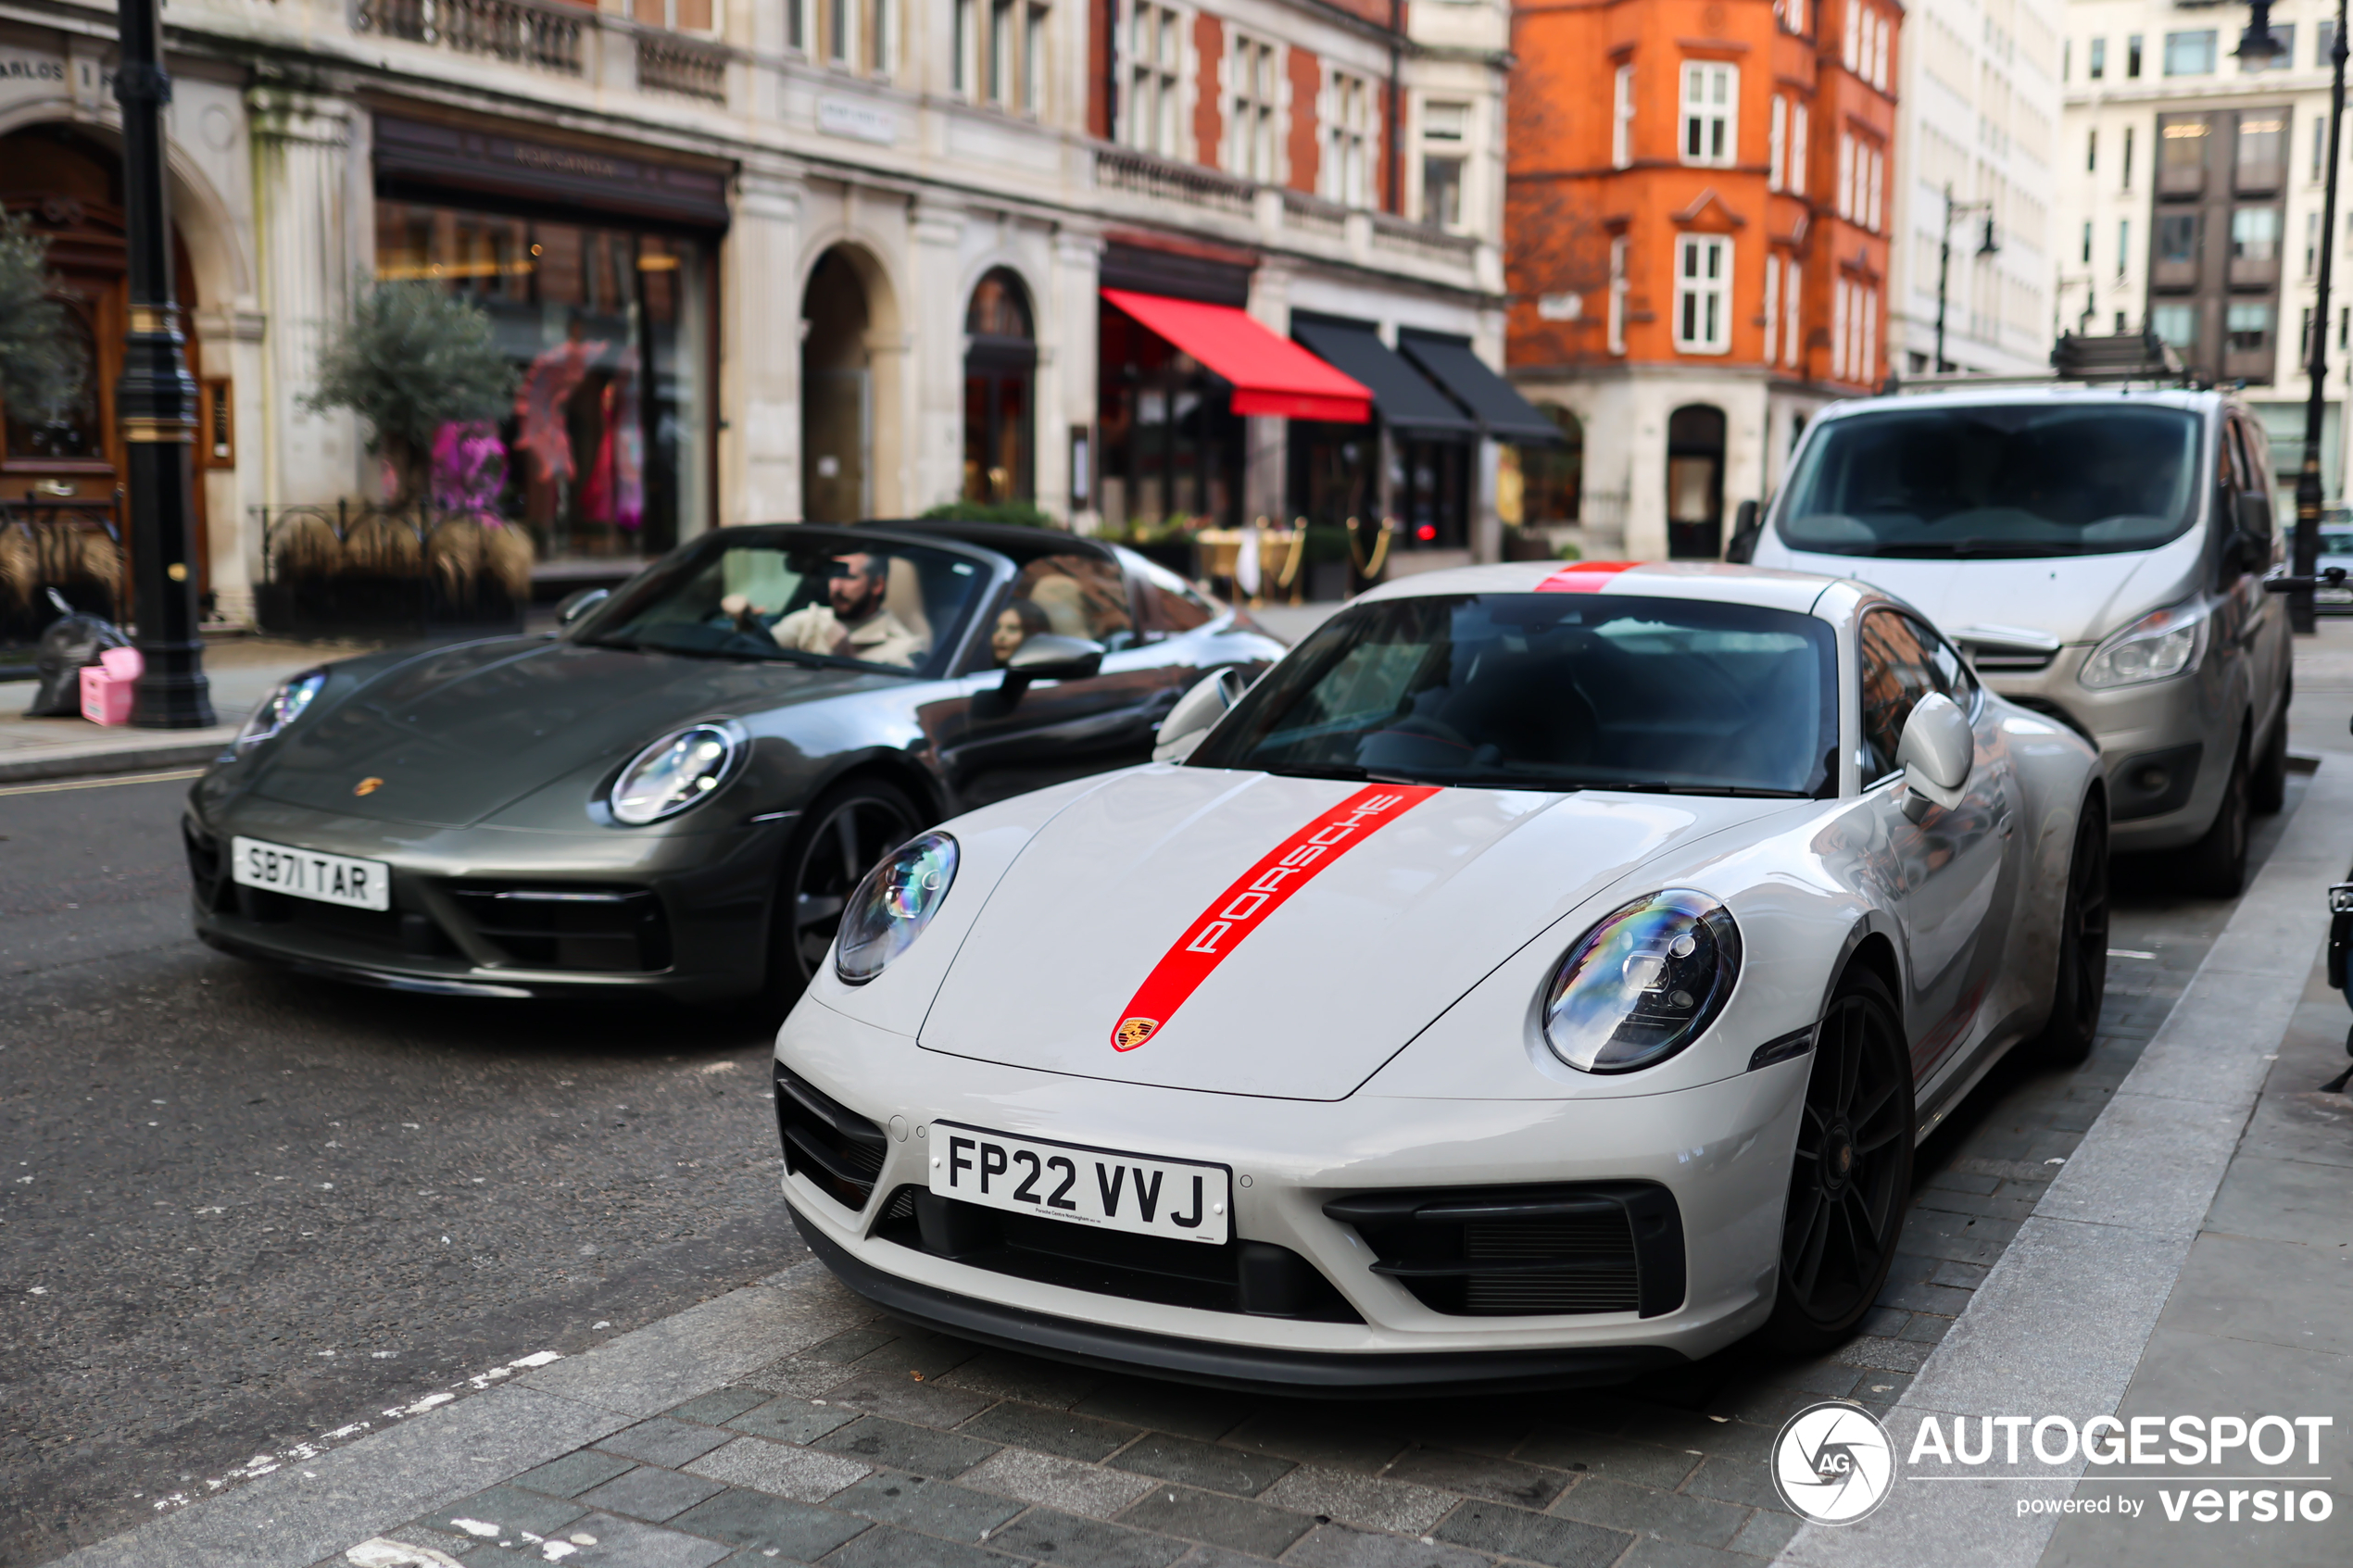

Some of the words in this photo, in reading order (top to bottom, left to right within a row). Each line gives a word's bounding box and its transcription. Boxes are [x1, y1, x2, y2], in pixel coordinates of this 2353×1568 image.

[248, 847, 305, 889] SB71
[311, 860, 368, 900] TAR
[1186, 794, 1403, 954] PORSCHE
[950, 1135, 1076, 1210] FP22
[1095, 1162, 1203, 1229] VVJ
